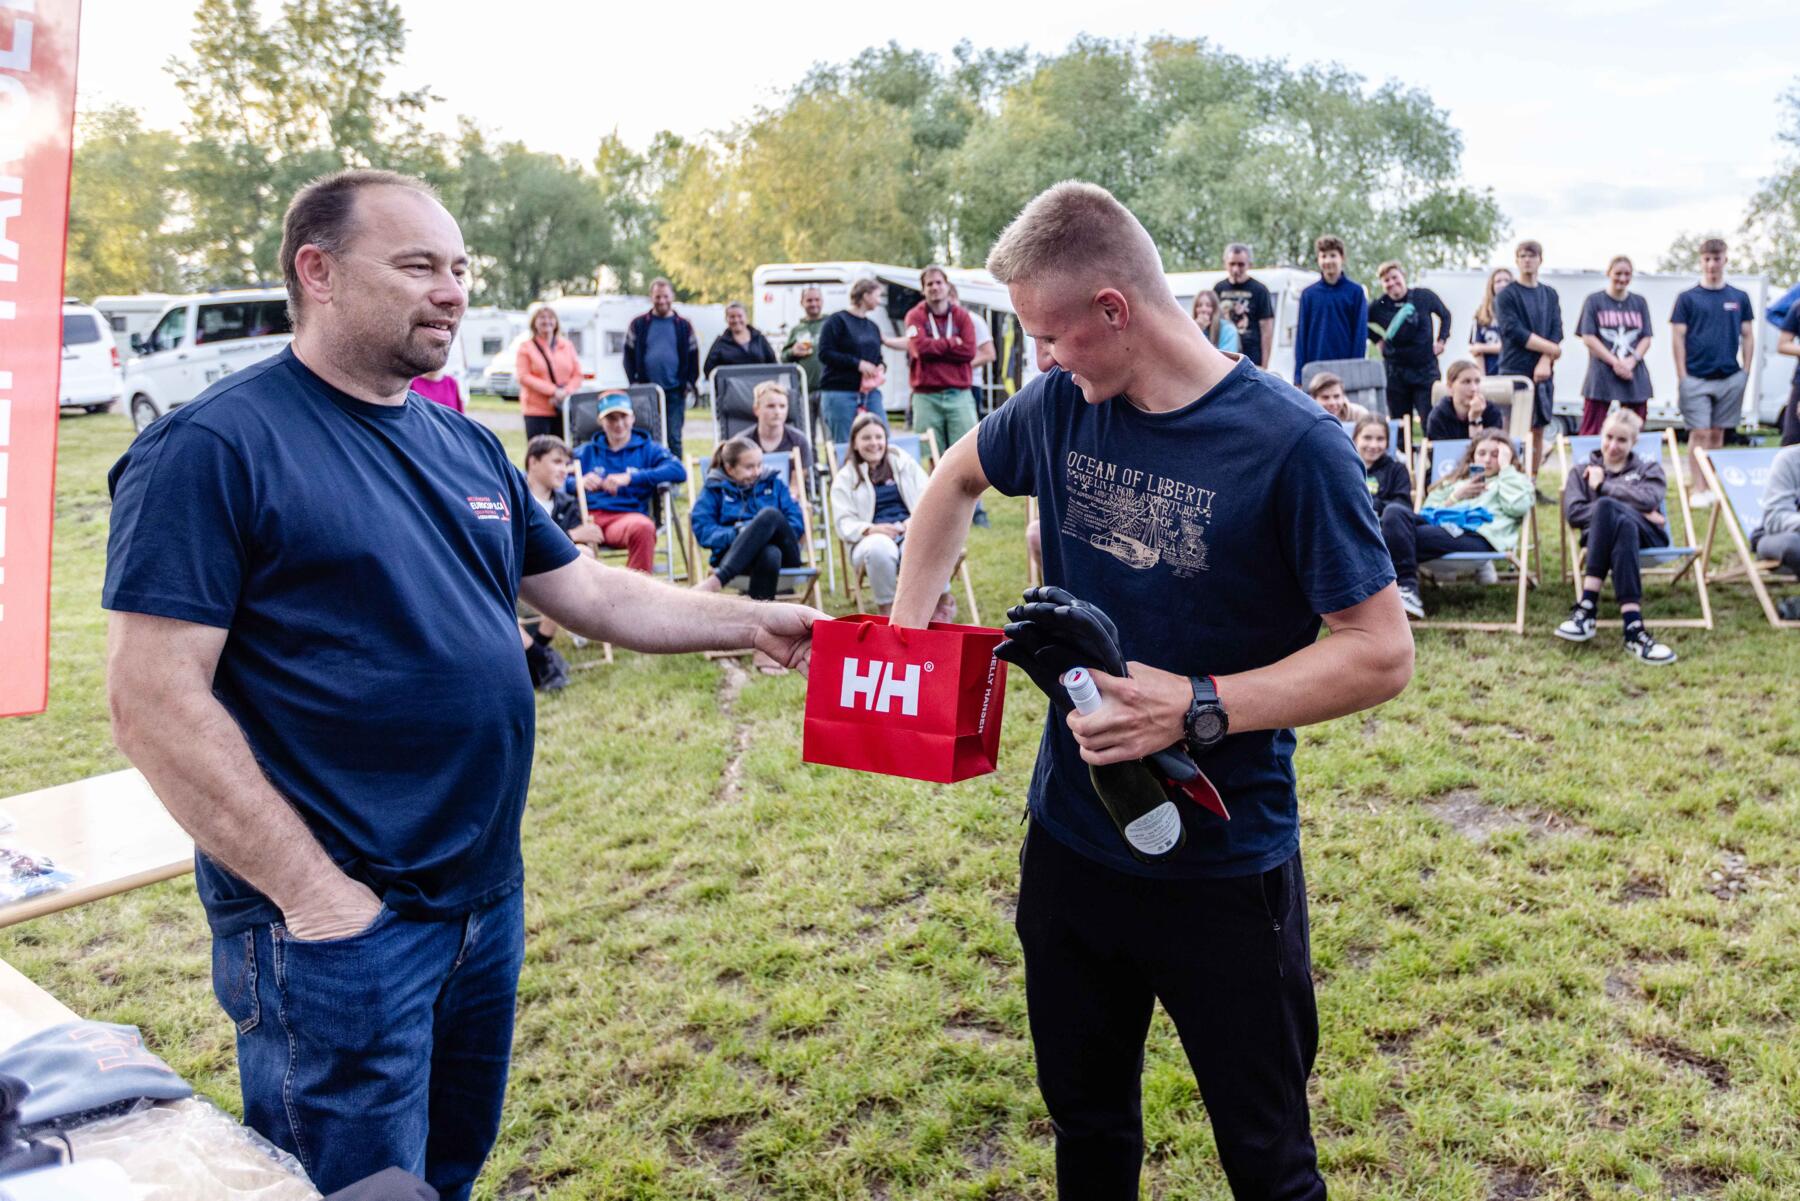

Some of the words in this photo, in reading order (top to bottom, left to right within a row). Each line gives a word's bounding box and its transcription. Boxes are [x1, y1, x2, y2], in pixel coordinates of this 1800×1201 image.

[1067, 451, 1117, 481] OCEAN
[1122, 468, 1144, 487] OF
[1147, 474, 1216, 509] LIBERTY
[1094, 479, 1115, 492] LIVE
[978, 688, 992, 734] HANSEN
